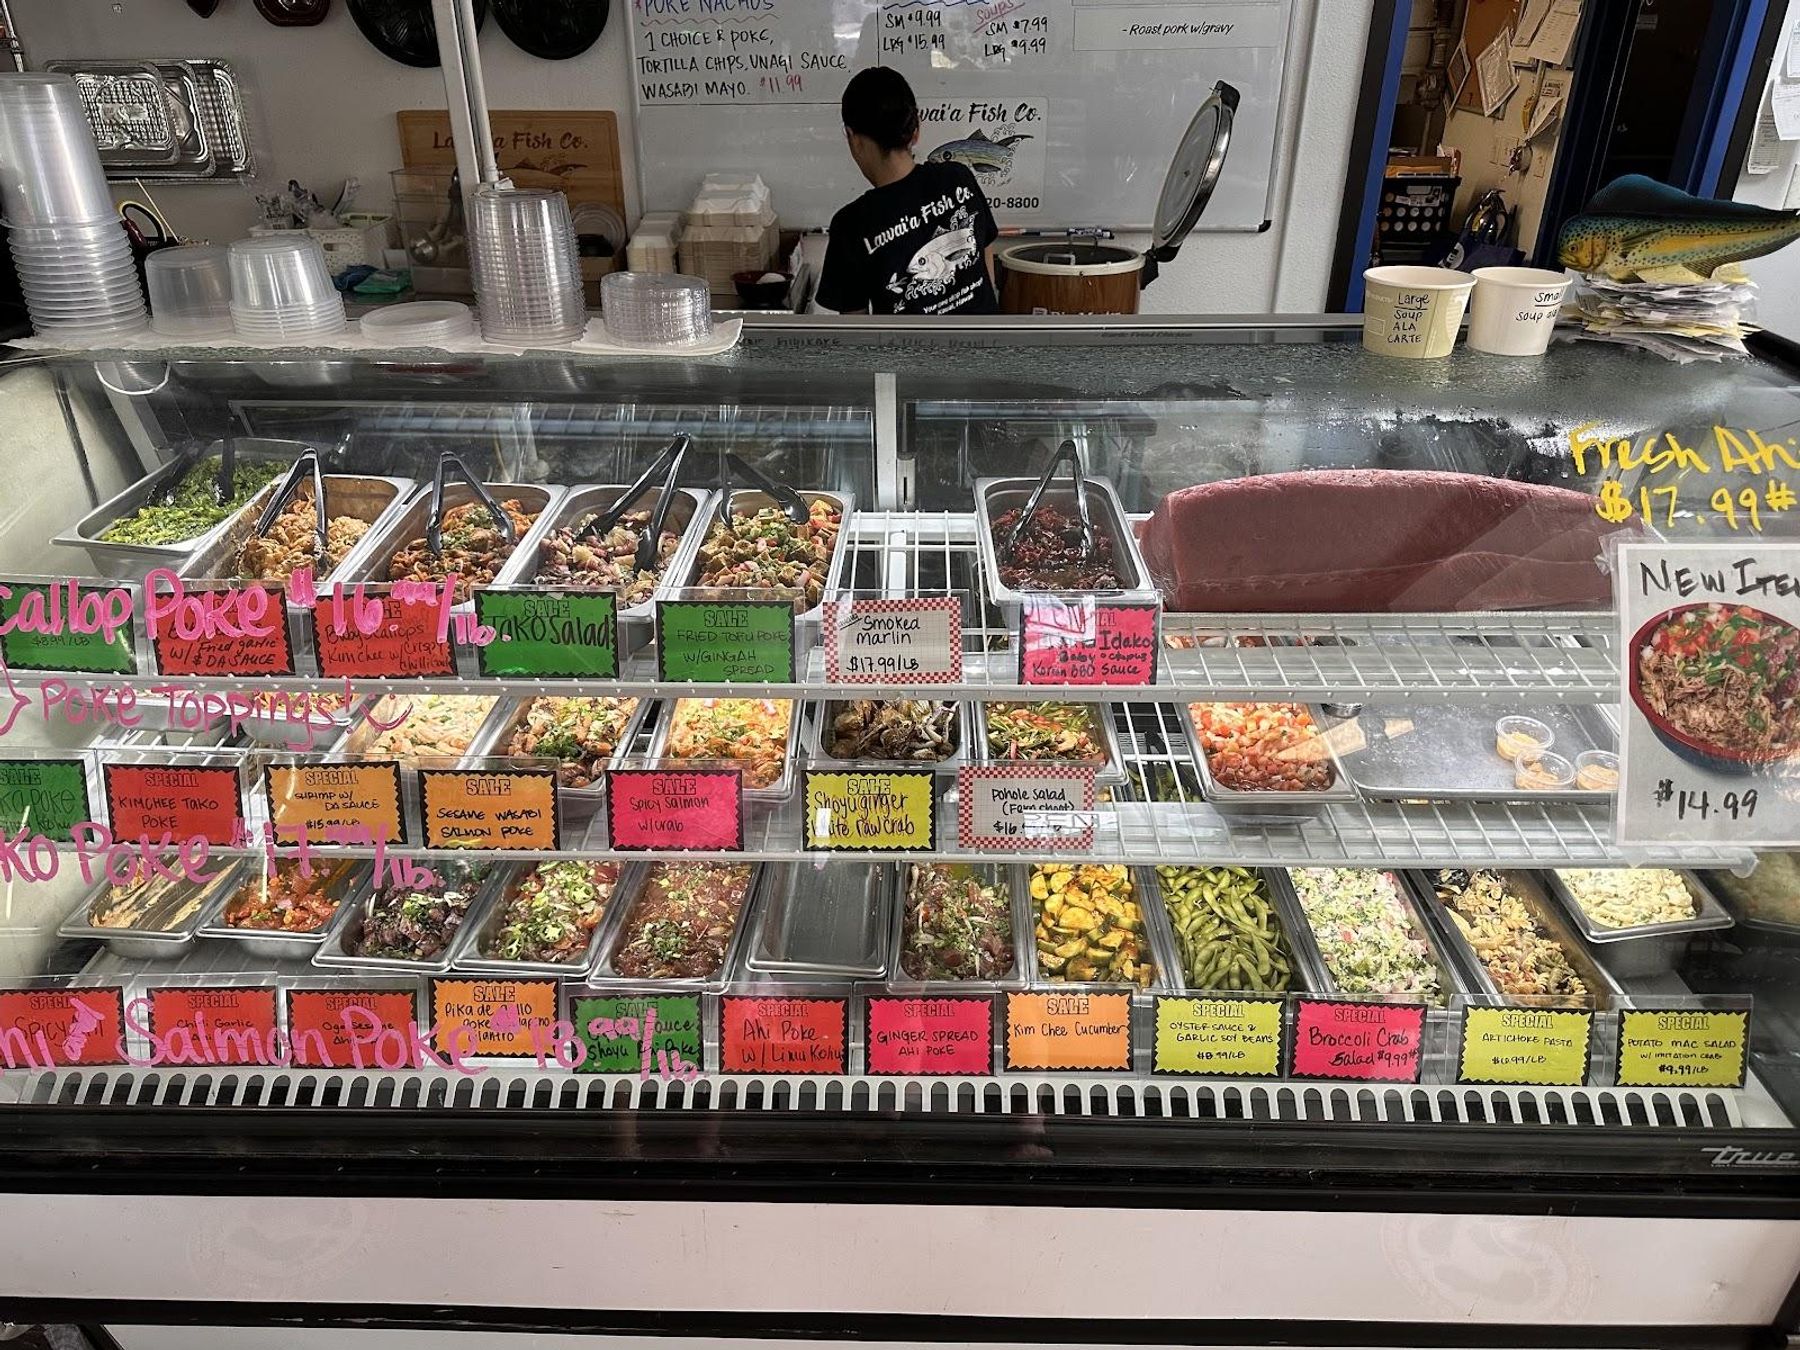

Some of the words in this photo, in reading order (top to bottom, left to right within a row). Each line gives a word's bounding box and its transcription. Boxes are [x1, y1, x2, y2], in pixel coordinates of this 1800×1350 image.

[885, 13, 906, 30] SM
[985, 22, 1008, 36] SM
[1162, 23, 1189, 37] pork
[661, 31, 713, 48] CHOICE
[638, 57, 699, 75] TORTILLA
[750, 54, 793, 75] UNAGI
[641, 82, 698, 100] WASABI
[968, 102, 1008, 123] Fish
[1013, 102, 1042, 123] Co.
[512, 131, 552, 150] Fish
[559, 131, 590, 149] Co.
[863, 215, 923, 256] Lawai'a
[919, 194, 955, 225] Fish
[954, 186, 974, 204] Co.
[1398, 291, 1430, 310] Large
[1394, 309, 1424, 322] Soup
[1387, 334, 1422, 344] CARTE
[1569, 421, 1712, 475] Fresh
[523, 600, 570, 618] SALE
[704, 610, 749, 627] SALE
[550, 614, 610, 650] Salad
[677, 630, 718, 643] FRIED
[721, 631, 754, 642] TOFU
[199, 641, 232, 652] Fried
[238, 637, 278, 654] garlic
[229, 653, 275, 667] SAUCE
[723, 664, 775, 676] SPREAD
[145, 773, 201, 788] SPECIAL
[305, 770, 360, 786] SPECIAL
[466, 778, 512, 796] SALE
[652, 778, 697, 796] SALE
[847, 778, 892, 796] SALE
[294, 791, 337, 801] SHRIMP
[1652, 778, 1758, 820] $14.99
[118, 797, 177, 811] KIMCHEE
[341, 799, 380, 810] SAUCE
[142, 815, 179, 829] POKE
[436, 808, 486, 821] SESAME
[495, 809, 542, 821] WASABI
[440, 826, 492, 838] SALMON
[501, 826, 535, 840] POKE
[187, 994, 240, 1008] SPECIAL
[474, 985, 516, 1002] SALE
[325, 997, 378, 1010] SPECIAL
[616, 1001, 659, 1018] SALE
[758, 1003, 809, 1017] SPECIAL
[904, 1003, 955, 1017] SPECIAL
[1047, 997, 1090, 1016] SALE
[1192, 1003, 1245, 1018] SPECIAL
[214, 1018, 254, 1028] Garlic
[1334, 1008, 1387, 1023] SPECIAL
[1501, 1013, 1554, 1029] SPECIAL
[1658, 1015, 1710, 1030] SPECIAL
[743, 1018, 771, 1041] Ahi
[781, 1020, 818, 1041] Poke
[1013, 1022, 1036, 1038] Kim
[1041, 1022, 1069, 1037] Chee
[1074, 1021, 1127, 1036] Cucumber
[1169, 1022, 1211, 1031] OYSTER
[1211, 1023, 1245, 1032] SAUCE
[876, 1030, 928, 1045] GINGER
[931, 1031, 979, 1042] SPREAD
[1176, 1032, 1219, 1043] GARLIC
[1220, 1034, 1238, 1042] SOY
[1241, 1032, 1275, 1044] BEANS
[1309, 1026, 1371, 1047] Broccoli
[1376, 1027, 1409, 1047] Crab
[1482, 1032, 1540, 1044] ARTICHOKE
[1543, 1037, 1573, 1048] PASTA
[1627, 1039, 1663, 1048] POTATO
[1671, 1039, 1699, 1048] MAC
[1703, 1040, 1737, 1048] SALAD
[926, 1044, 956, 1056] POKE
[1701, 1145, 1800, 1166] true
